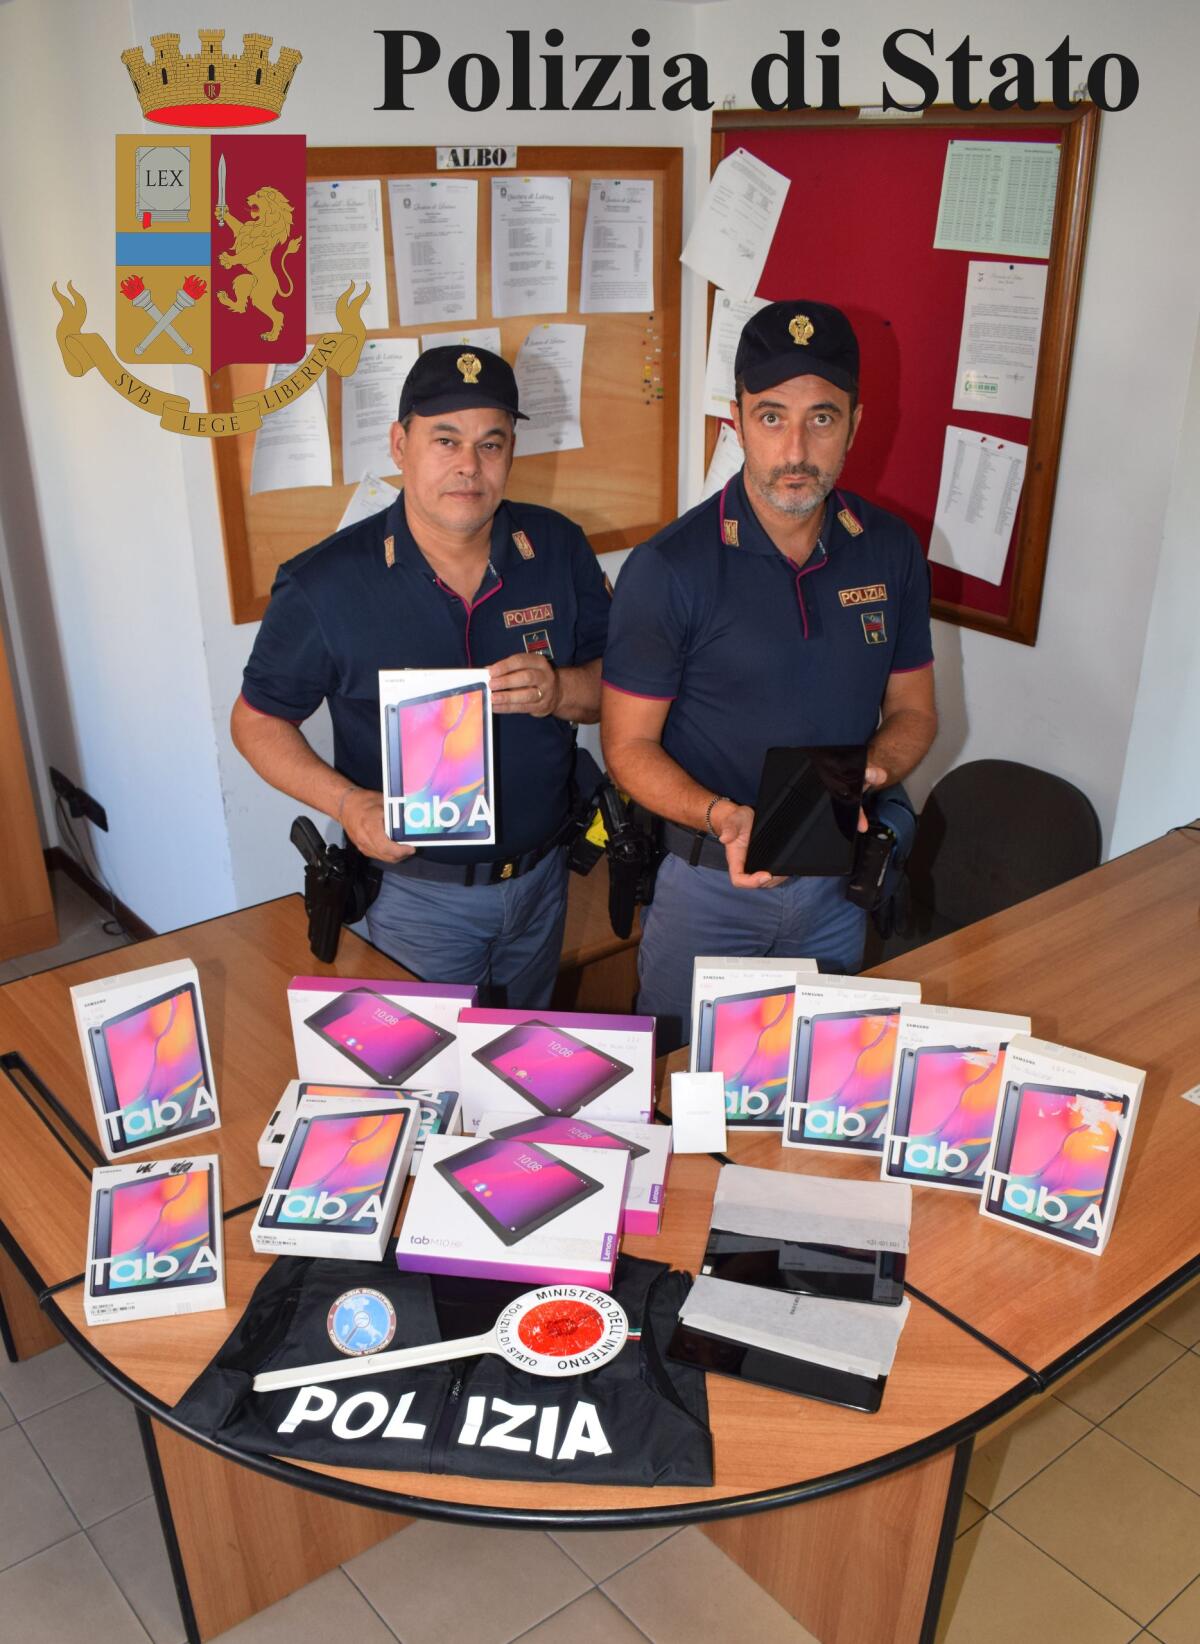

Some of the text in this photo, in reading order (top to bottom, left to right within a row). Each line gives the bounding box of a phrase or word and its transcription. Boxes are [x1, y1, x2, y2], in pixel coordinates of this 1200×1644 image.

[446, 148, 508, 168] ALBO
[839, 587, 887, 605] POLIZIA
[505, 607, 552, 626] POLIZIA
[388, 794, 492, 829] Tab A
[103, 1086, 217, 1141] Tab A
[725, 1085, 769, 1115] ab
[789, 1101, 866, 1137] Tab
[517, 1154, 543, 1172] 10:08
[889, 1135, 969, 1173] Tab
[267, 1190, 385, 1223] Tab A
[651, 1185, 660, 1204] Lenovo
[988, 1169, 1104, 1240] Tab A
[604, 1234, 613, 1261] Lenovo
[91, 1245, 219, 1286] Tab A
[535, 1288, 612, 1310] MINISTERO
[499, 1303, 538, 1367] POLIZIA DI STATO
